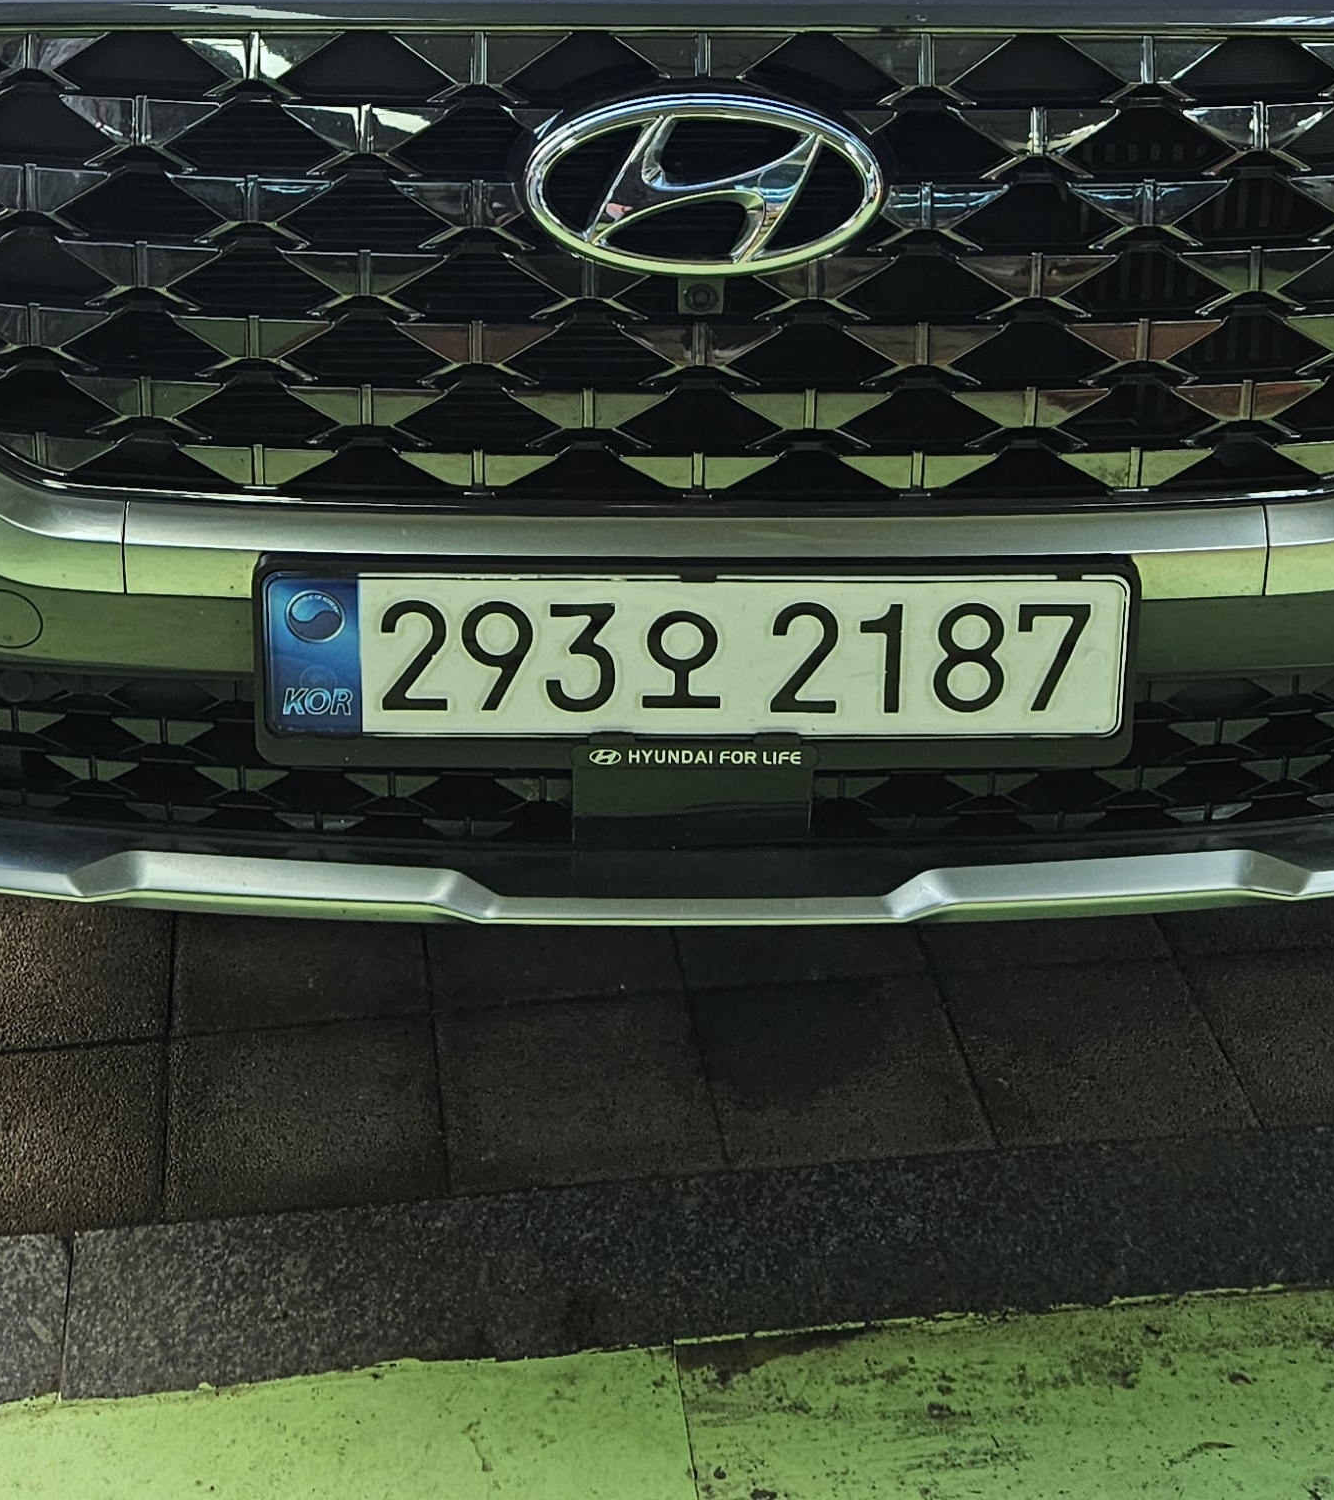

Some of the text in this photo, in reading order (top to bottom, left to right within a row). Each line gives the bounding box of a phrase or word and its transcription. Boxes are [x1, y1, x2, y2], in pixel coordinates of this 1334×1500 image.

[379, 599, 1092, 714] 293오 2187
[282, 687, 353, 716] KOR
[627, 749, 802, 765] HYUNDAI FOR LIFE
